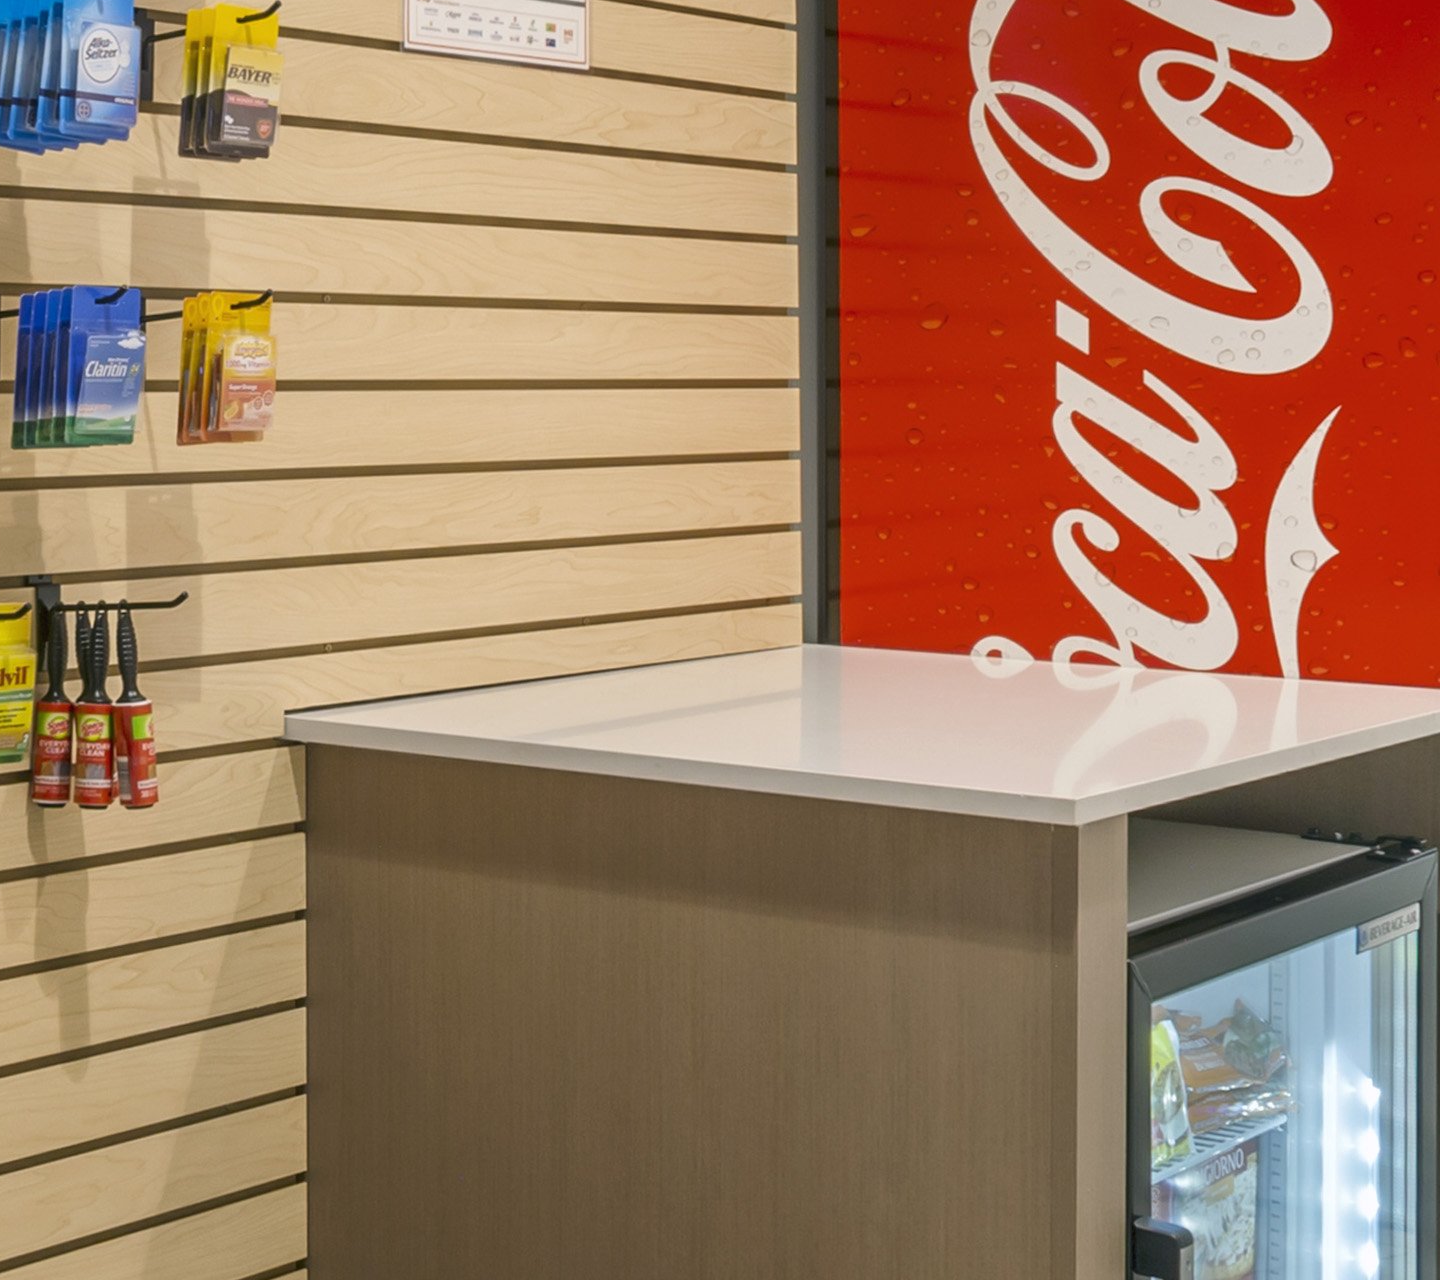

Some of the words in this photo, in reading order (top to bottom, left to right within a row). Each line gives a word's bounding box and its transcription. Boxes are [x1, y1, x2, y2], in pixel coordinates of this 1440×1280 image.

[84, 46, 118, 61] Seltzer
[228, 64, 272, 86] BAYER
[85, 360, 127, 380] Claritin
